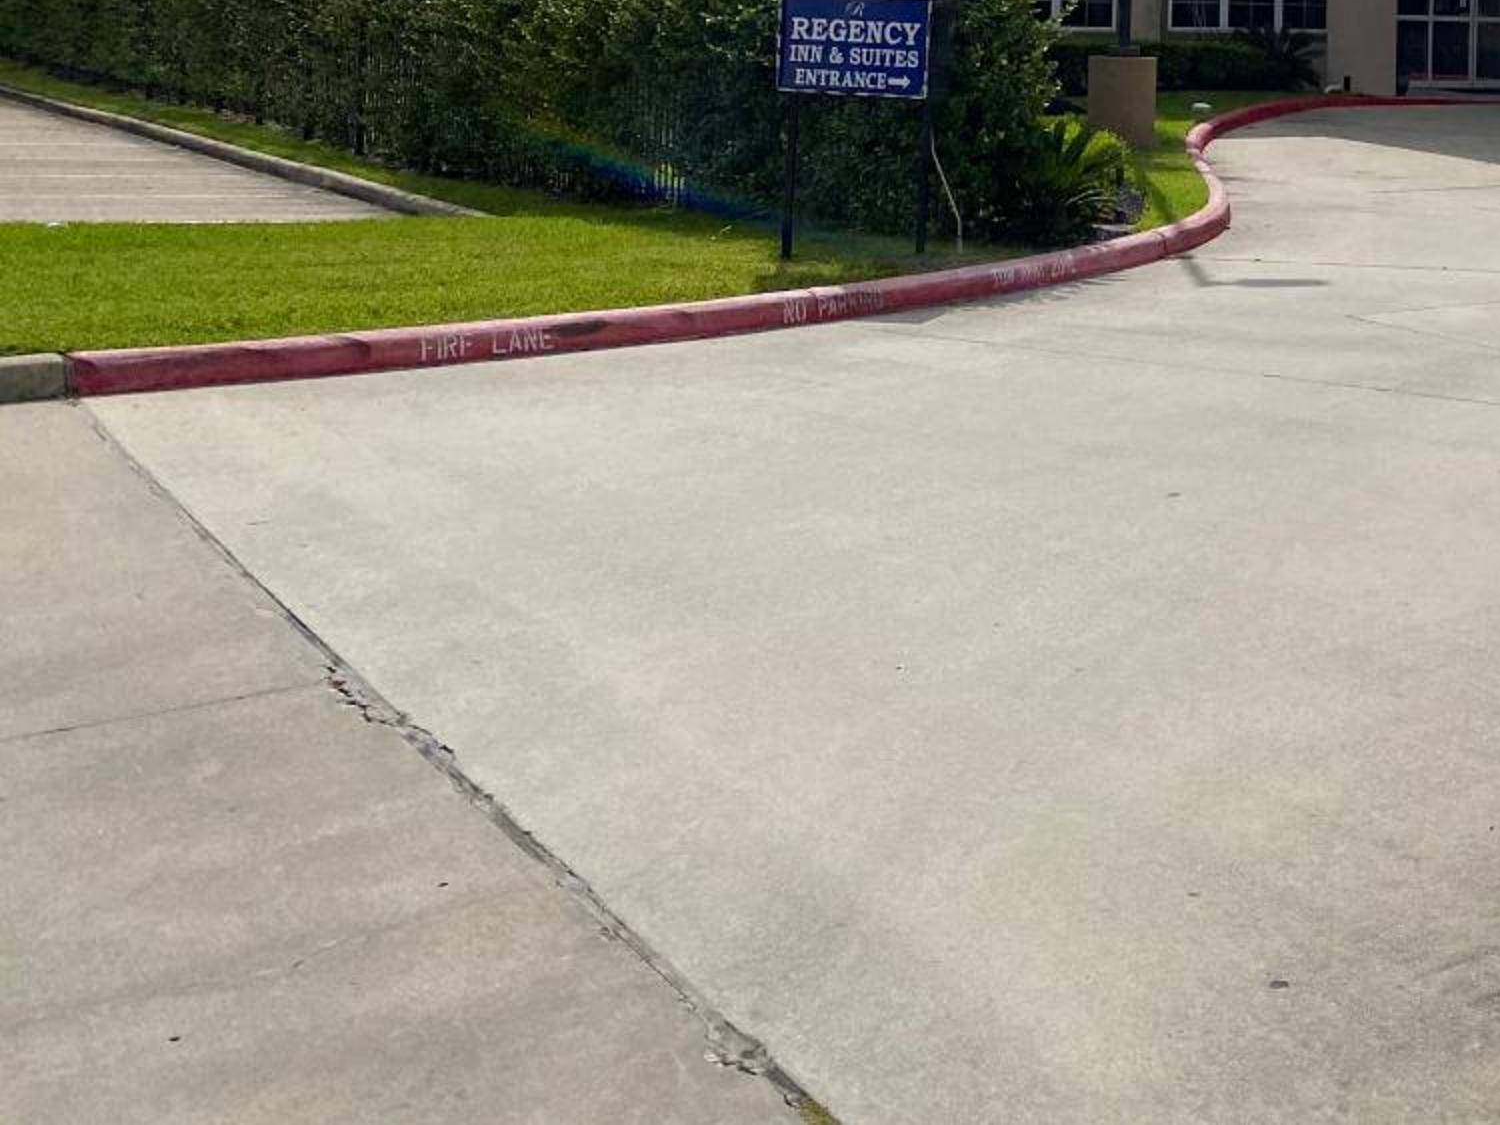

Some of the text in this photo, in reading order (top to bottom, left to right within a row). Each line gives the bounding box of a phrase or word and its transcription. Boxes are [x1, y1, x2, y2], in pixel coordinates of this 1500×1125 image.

[790, 17, 921, 46] REGENCY
[788, 44, 919, 68] INN & SUITES
[794, 68, 887, 89] ENTRANCE
[492, 326, 555, 354] LANE
